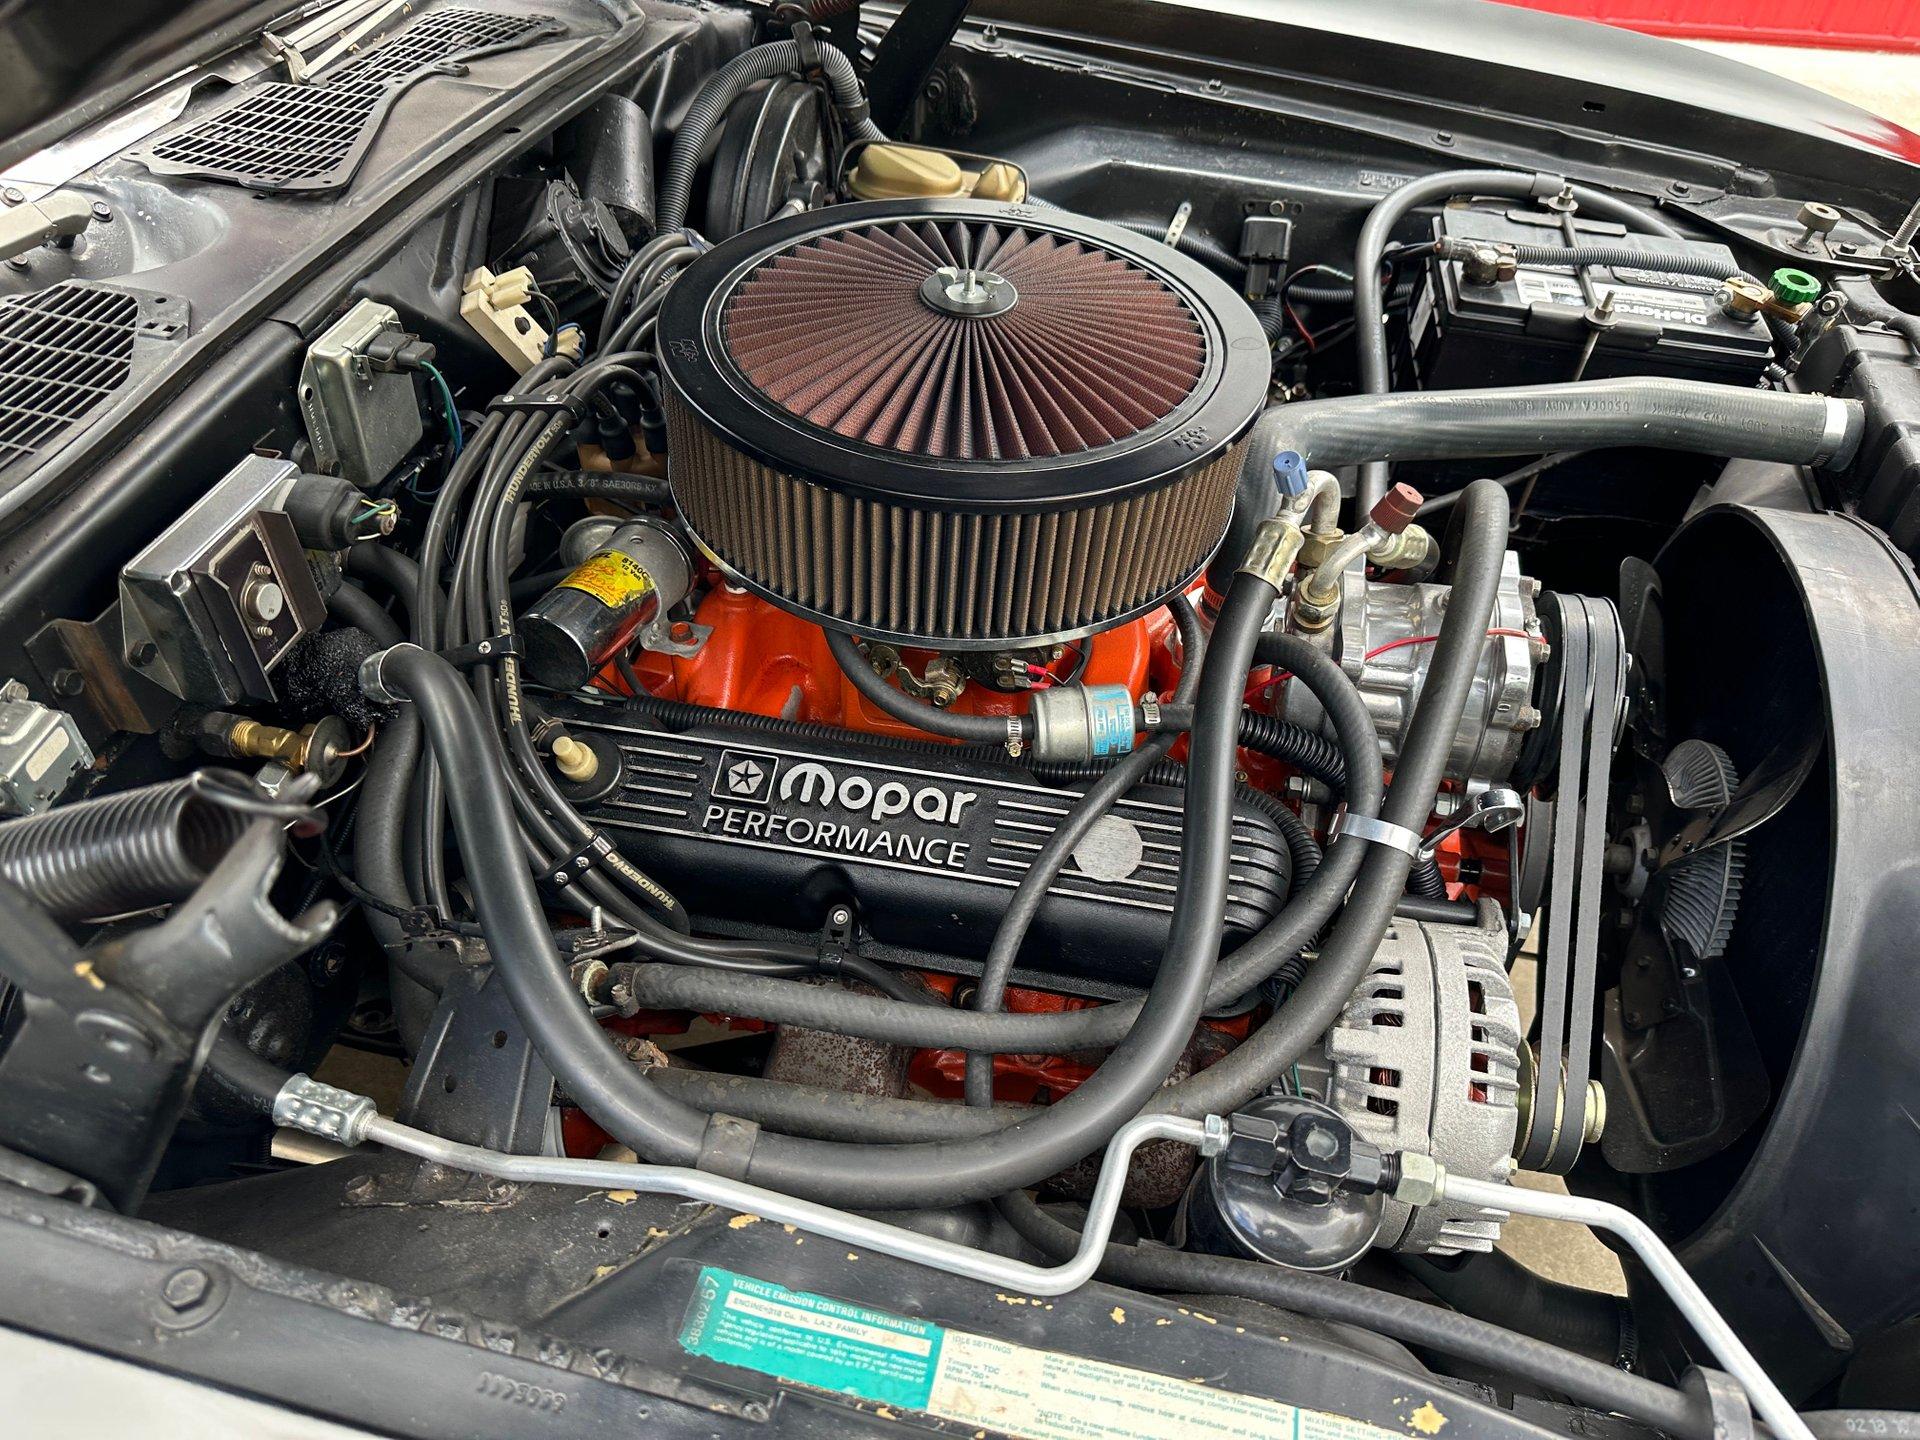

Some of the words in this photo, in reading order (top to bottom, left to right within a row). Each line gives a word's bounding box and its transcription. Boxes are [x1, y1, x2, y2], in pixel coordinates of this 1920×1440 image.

[1613, 302, 1708, 326] DieHard
[504, 429, 554, 505] THUNDERVOLT
[779, 762, 978, 826] Mopar
[702, 804, 971, 869] PERFORMANCE
[732, 1278, 771, 1296] VEHICLE
[772, 1289, 815, 1308] EMISSION
[815, 1300, 860, 1320] CONTROL
[861, 1311, 925, 1336] INFORMATION
